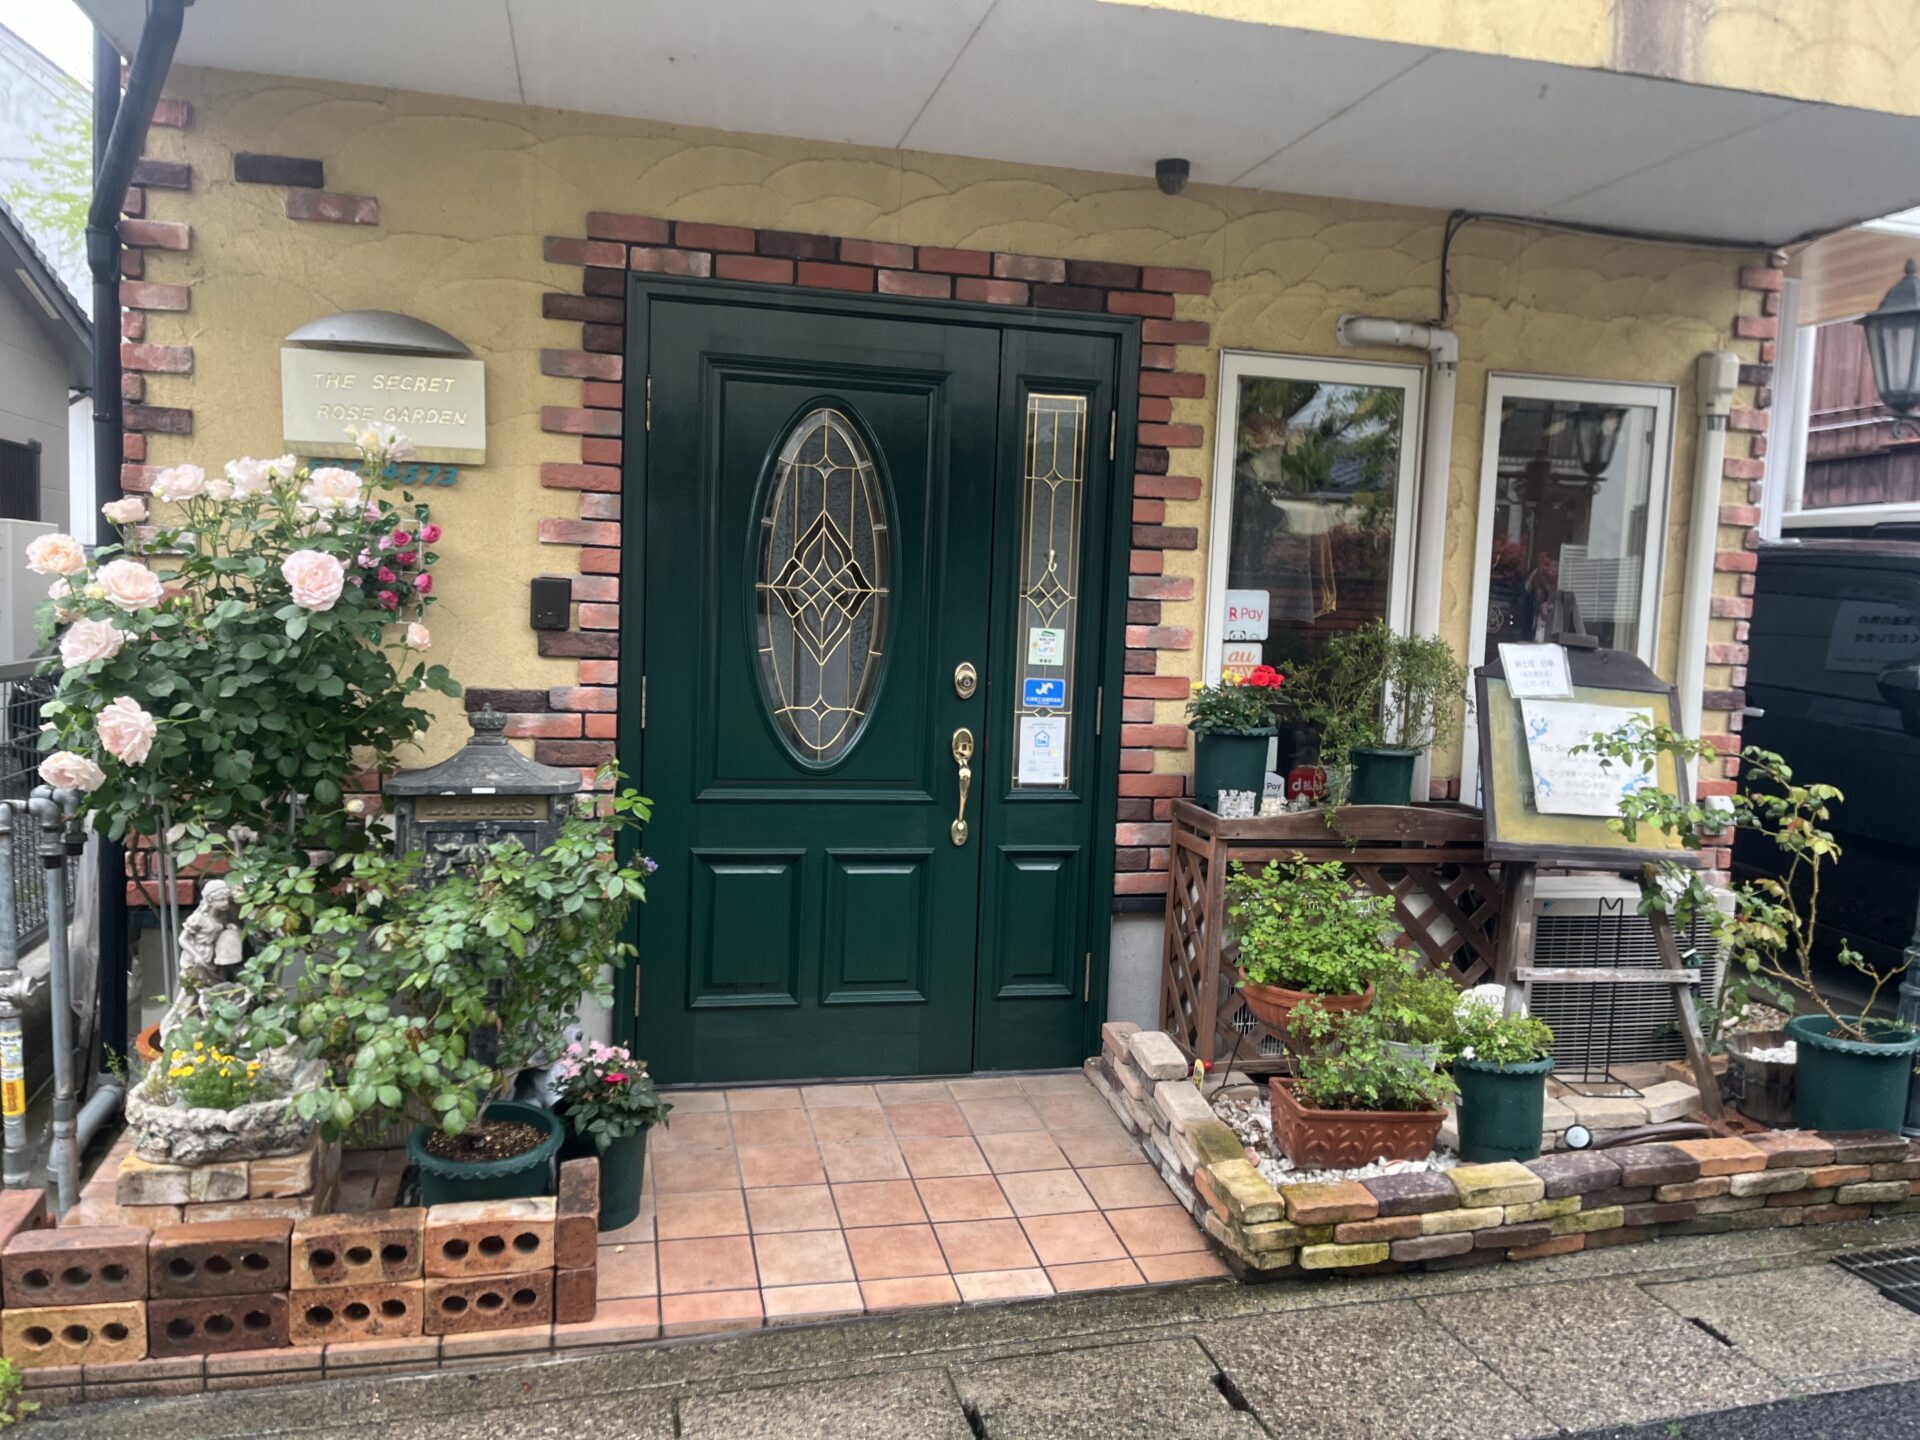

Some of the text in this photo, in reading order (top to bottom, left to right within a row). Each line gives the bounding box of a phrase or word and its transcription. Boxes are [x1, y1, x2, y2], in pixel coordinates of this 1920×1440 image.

[312, 373, 456, 393] THE SECRET
[316, 404, 467, 426] ROSE GARDEN
[1240, 607, 1264, 622] Pay
[1228, 651, 1256, 664] au
[426, 798, 536, 817] LETTERS
